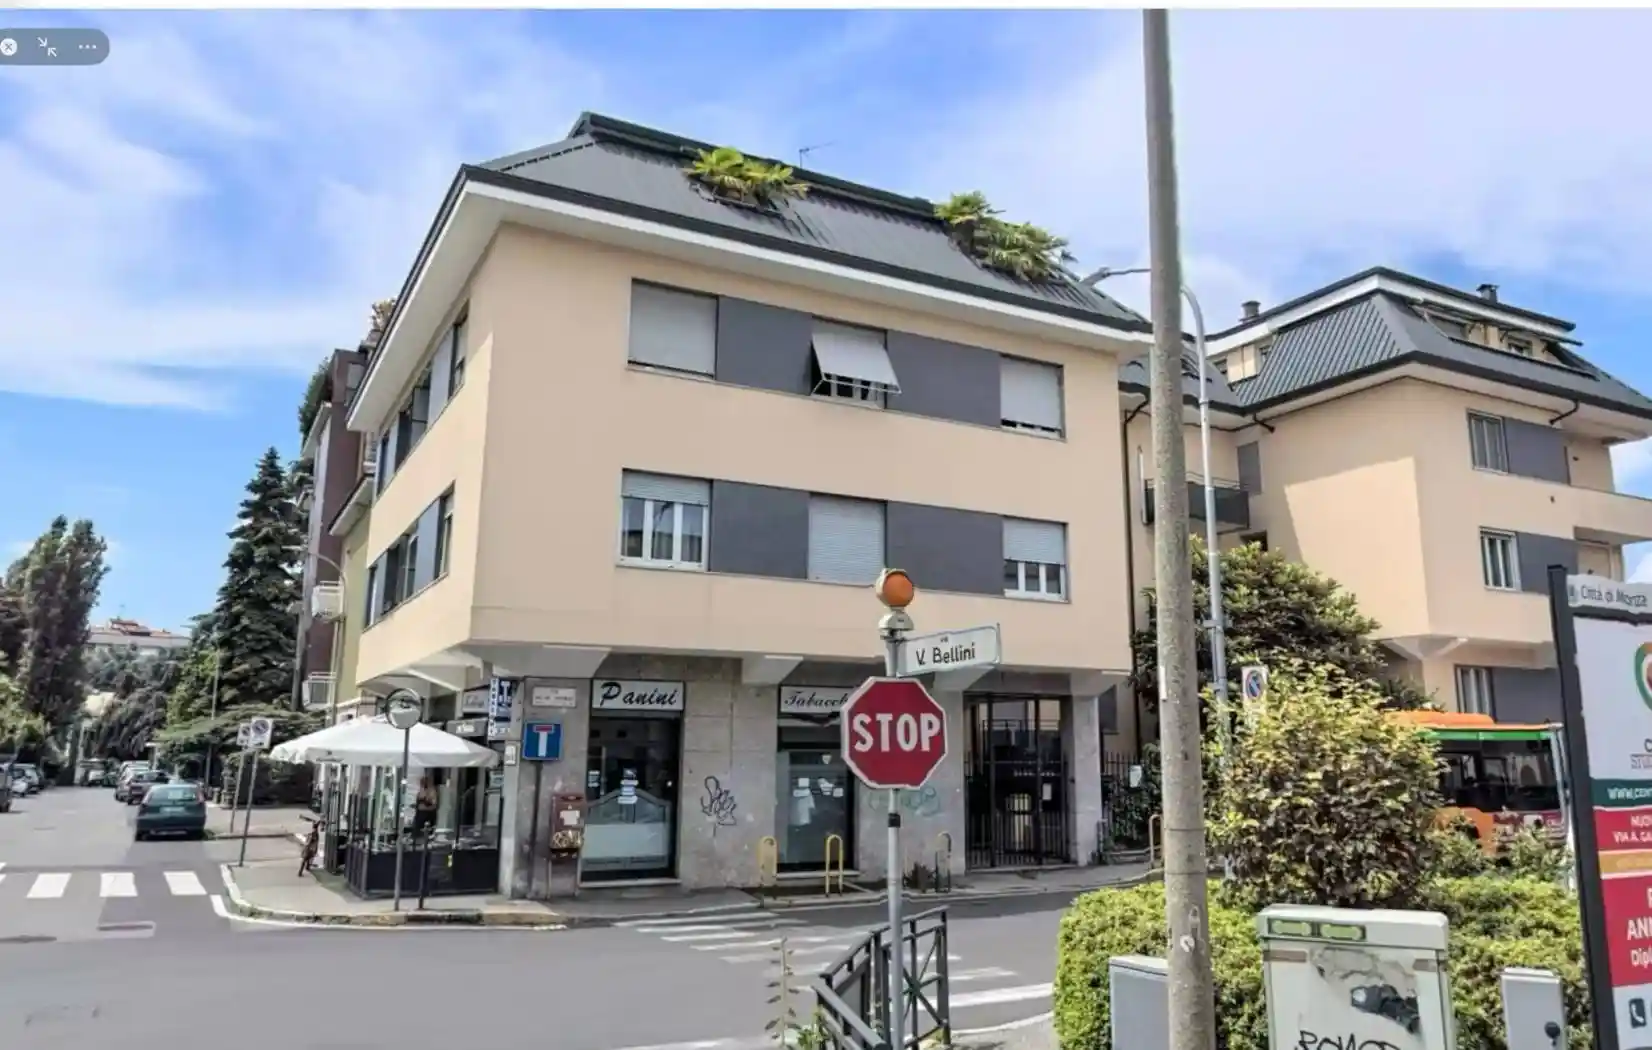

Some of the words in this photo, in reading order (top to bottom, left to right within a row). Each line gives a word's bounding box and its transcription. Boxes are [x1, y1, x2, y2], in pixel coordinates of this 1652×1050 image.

[916, 647, 927, 667] V.
[932, 641, 976, 664] Bellini
[600, 681, 677, 707] Panini
[852, 713, 941, 753] STOP
